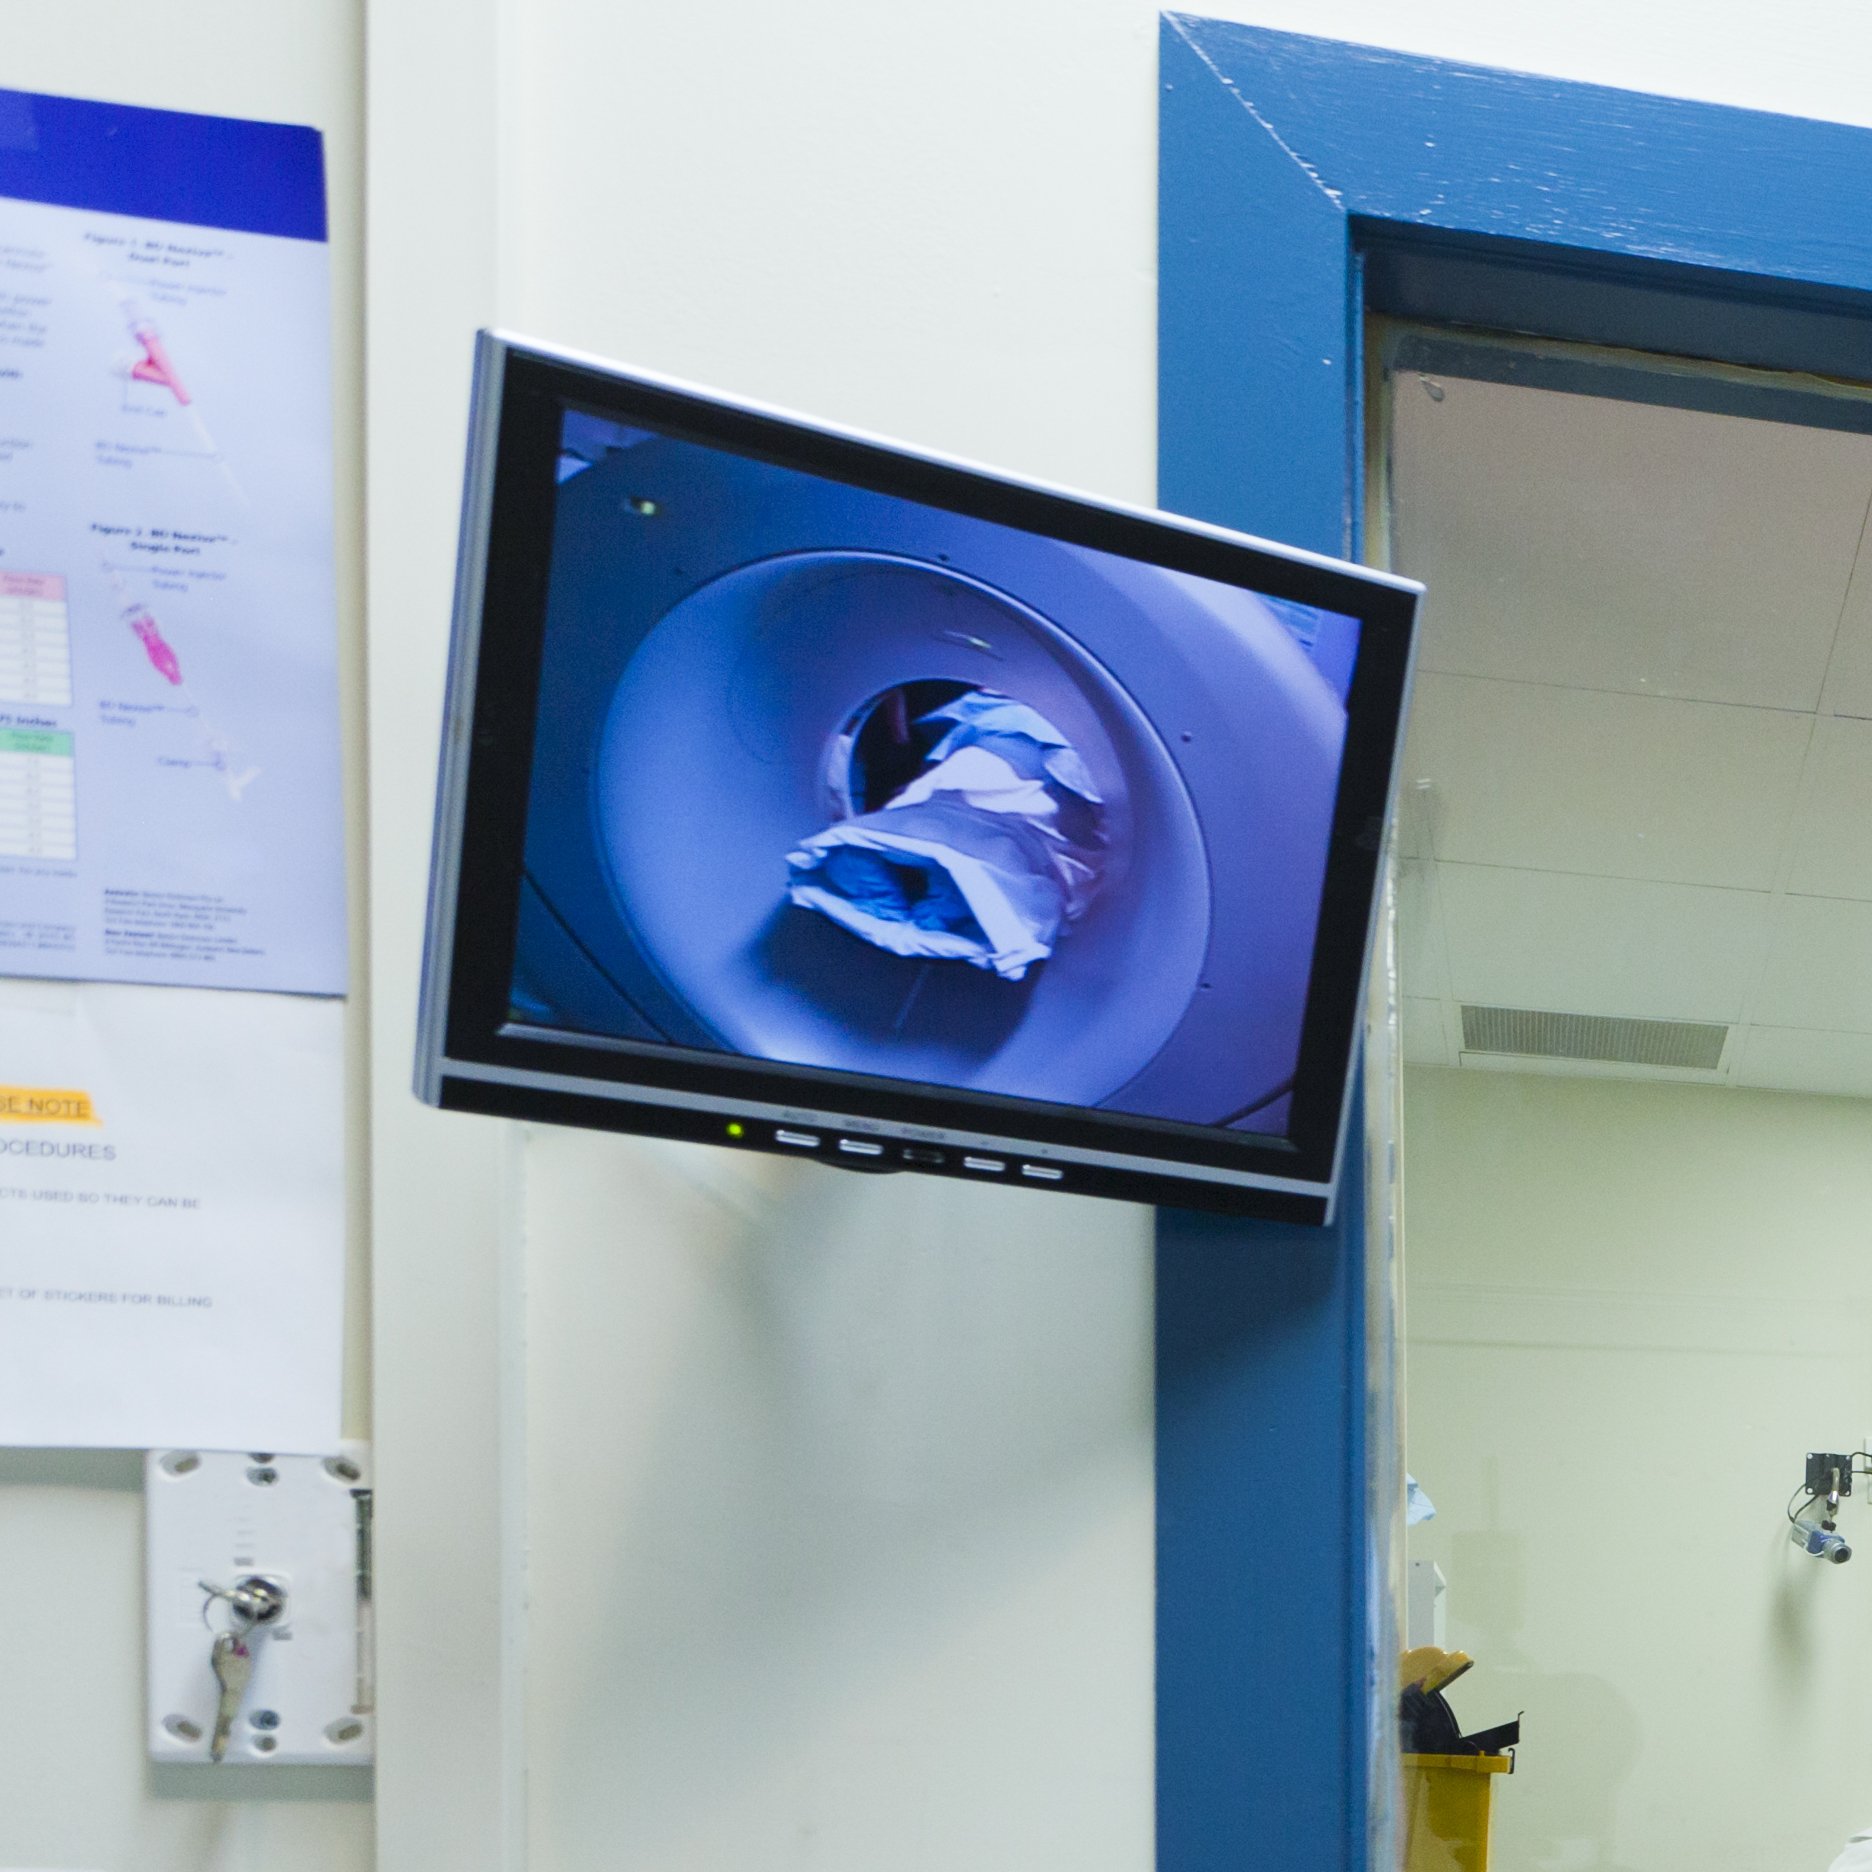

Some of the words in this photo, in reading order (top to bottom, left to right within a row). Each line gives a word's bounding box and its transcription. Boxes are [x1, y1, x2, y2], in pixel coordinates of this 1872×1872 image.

[29, 1097, 88, 1119] NOTE
[33, 1190, 73, 1203] USED
[79, 1192, 99, 1204] SO
[104, 1194, 142, 1206] THEY
[148, 1196, 177, 1208] CAN
[182, 1198, 200, 1209] BE
[44, 1289, 117, 1304] STICKERS
[122, 1292, 152, 1305] FOR
[157, 1294, 212, 1308] BILLING
